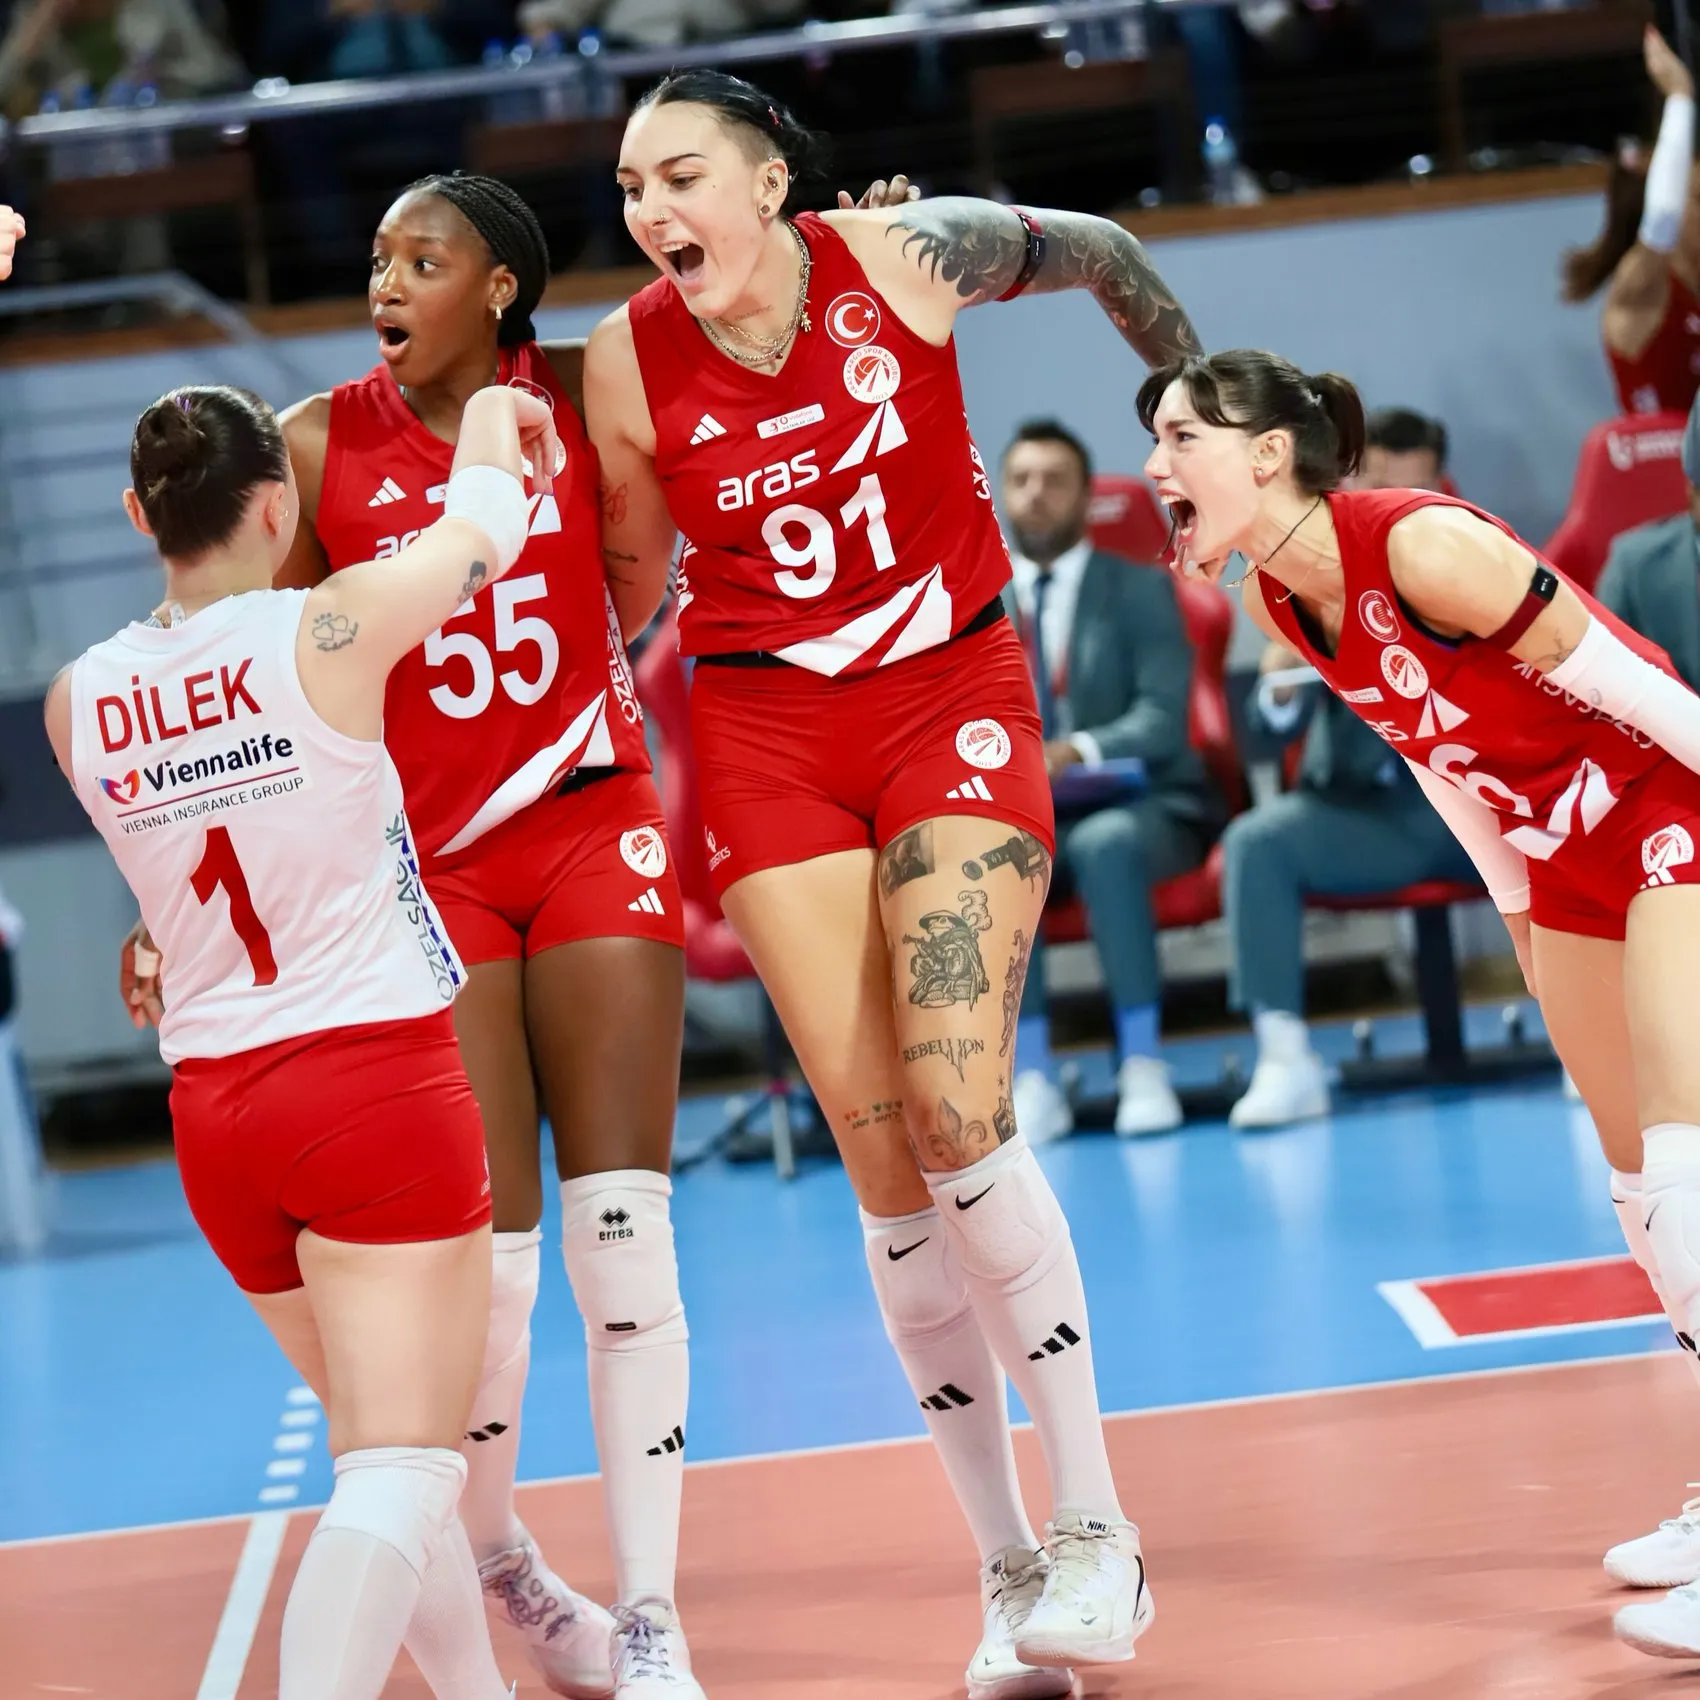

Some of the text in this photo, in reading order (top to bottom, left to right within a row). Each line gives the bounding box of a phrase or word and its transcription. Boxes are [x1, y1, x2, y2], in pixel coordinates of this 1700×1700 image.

[863, 347, 883, 356] SPOR
[716, 448, 821, 512] aras
[760, 472, 897, 599] 91
[424, 572, 559, 719] 55
[96, 656, 263, 754] DİLEK
[143, 732, 294, 792] Viennalife
[121, 776, 305, 835] VIENNA INSURANCE GROUP
[189, 825, 279, 987] 1
[903, 1037, 985, 1084] REBELLION
[1086, 1519, 1108, 1533] NIKE
